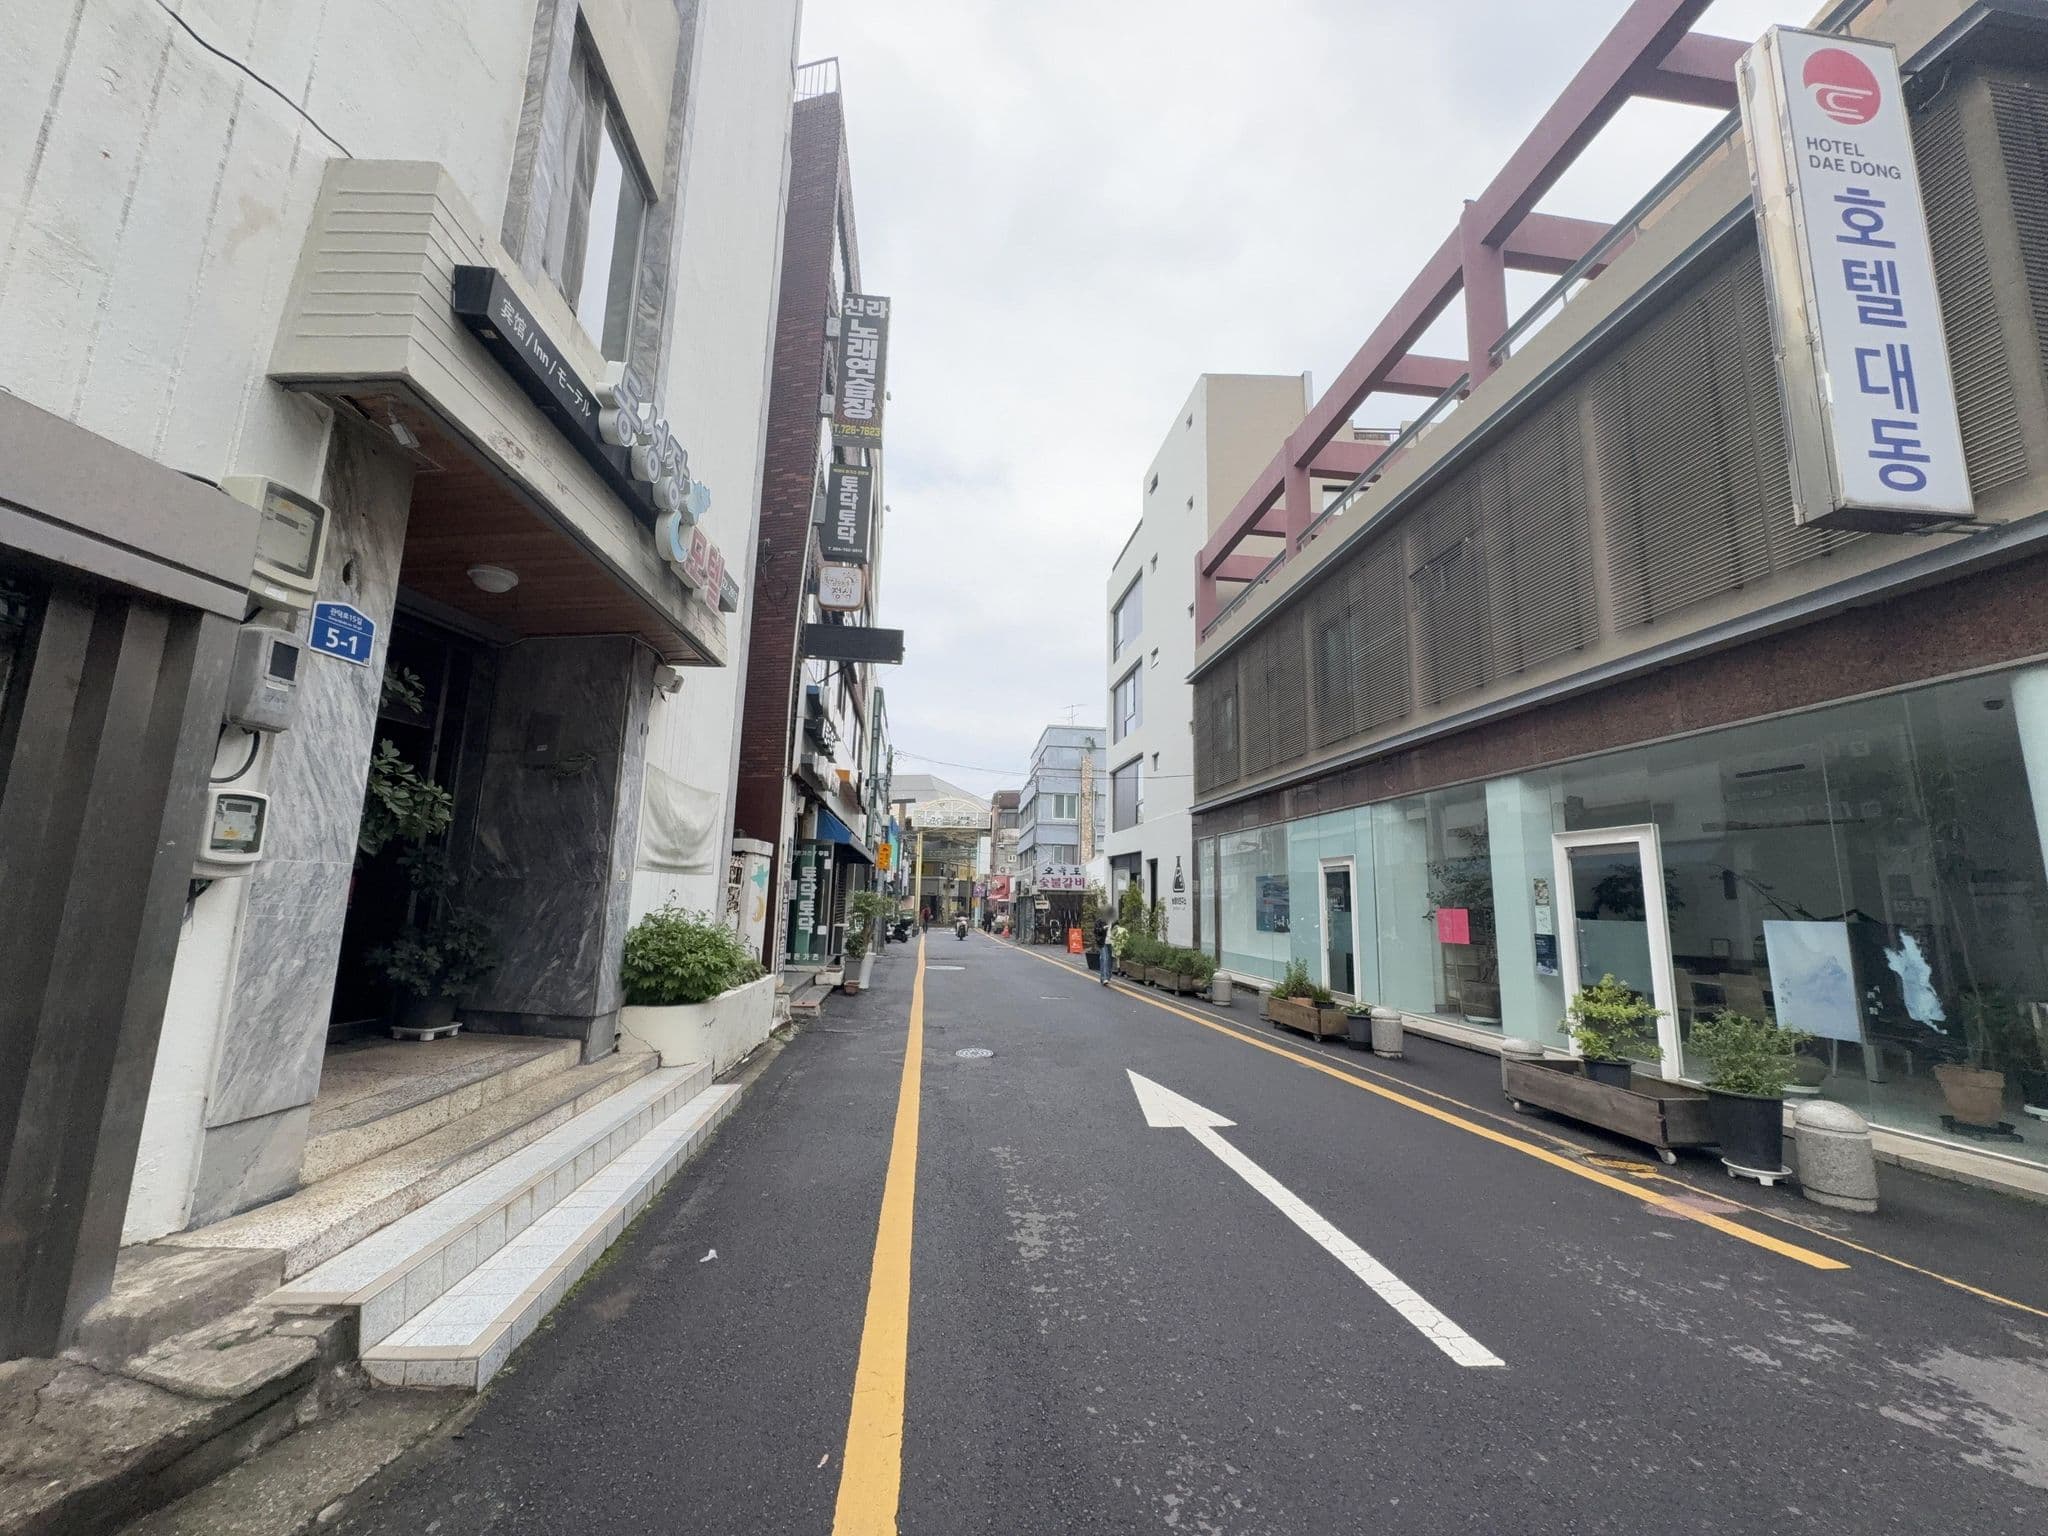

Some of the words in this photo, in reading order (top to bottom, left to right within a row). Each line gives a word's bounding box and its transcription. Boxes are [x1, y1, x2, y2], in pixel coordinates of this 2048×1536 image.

[1806, 136, 1865, 157] HOTEL
[1809, 155, 1846, 172] DAE
[1850, 160, 1901, 180] DONG
[844, 297, 888, 318] 신라
[500, 298, 527, 340] 宾馆
[557, 366, 591, 417] モーテル
[842, 319, 879, 420] 노래연습장
[684, 526, 725, 613] 모텔
[325, 627, 358, 655] 5-1
[1039, 877, 1086, 889] 숯불갈비
